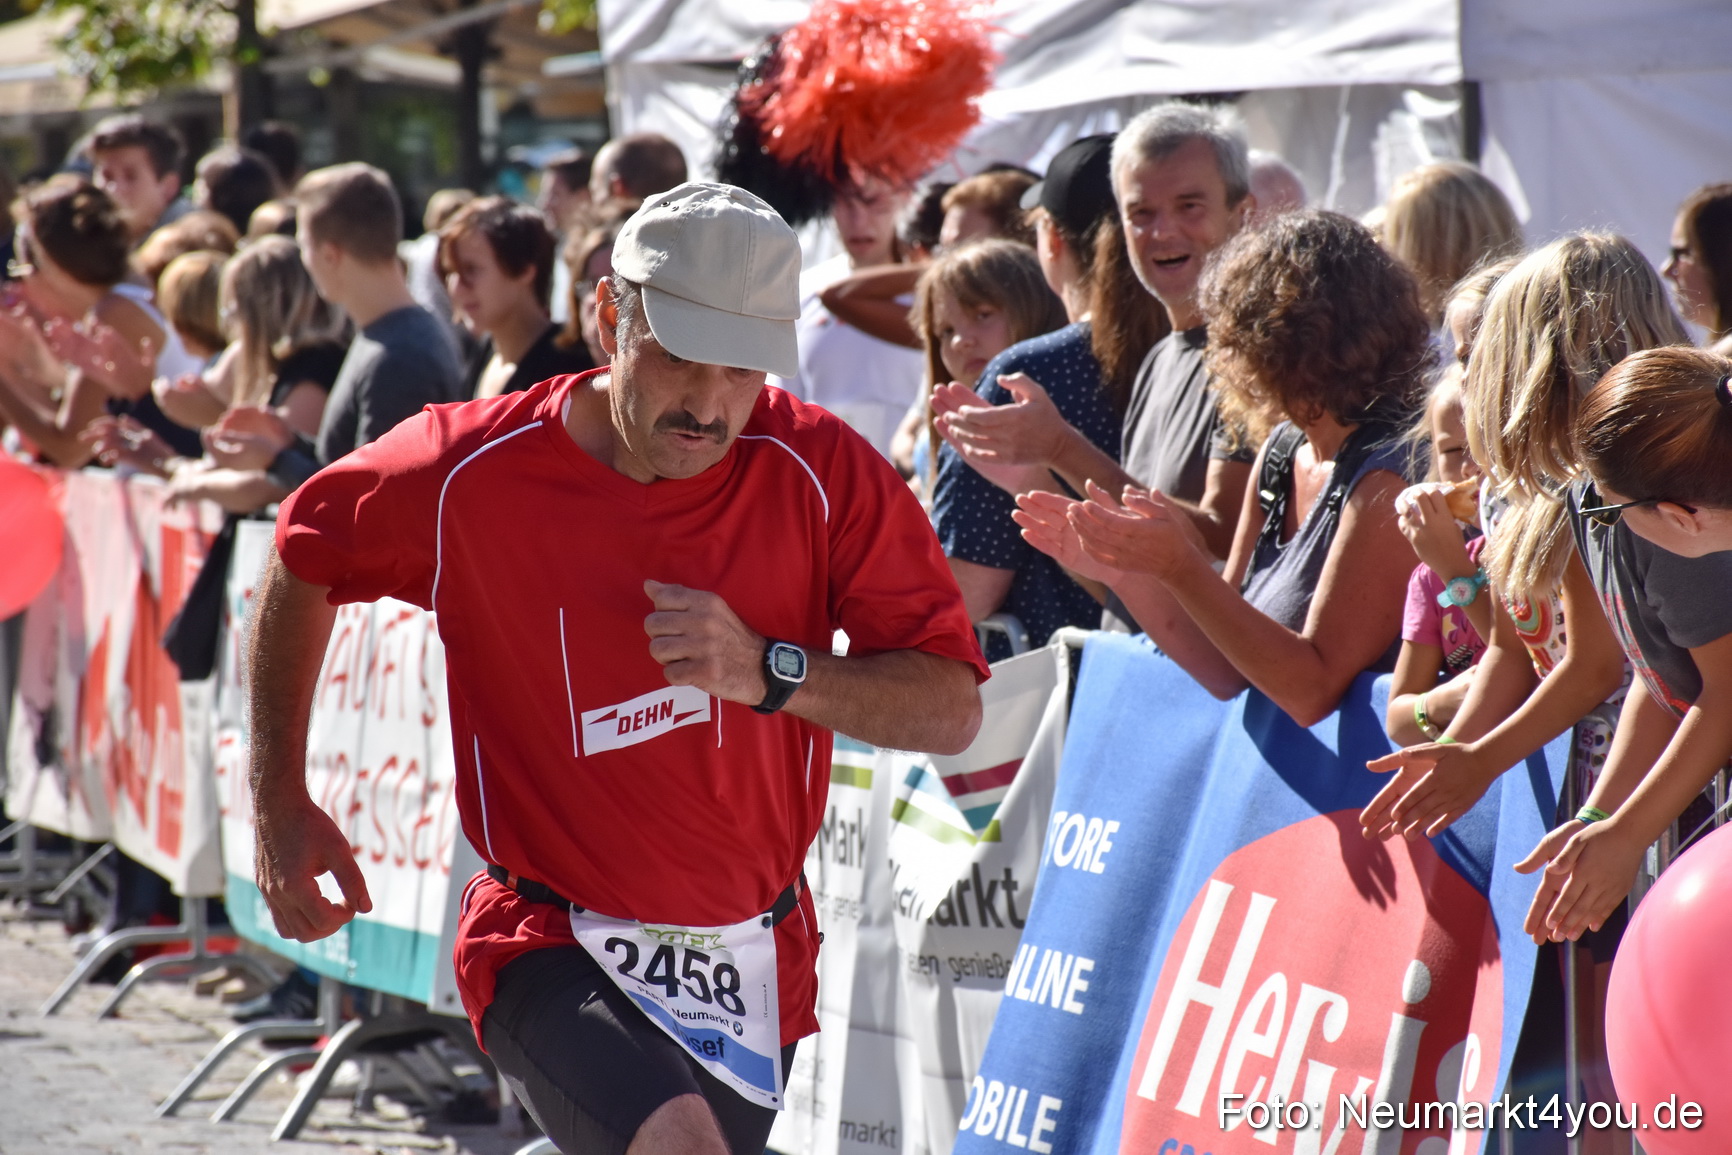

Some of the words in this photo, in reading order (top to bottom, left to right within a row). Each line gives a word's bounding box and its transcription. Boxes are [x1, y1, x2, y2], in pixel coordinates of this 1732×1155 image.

[617, 698, 674, 736] DEHN
[1045, 810, 1120, 874] TORE
[927, 861, 1026, 930] arkt
[604, 936, 747, 1017] 2458
[1005, 943, 1095, 1015] NLINE
[671, 1007, 730, 1028] Neumarkt
[672, 1020, 725, 1059] Josef
[1137, 878, 1481, 1155] Hervis
[959, 1075, 1063, 1155] OBILE
